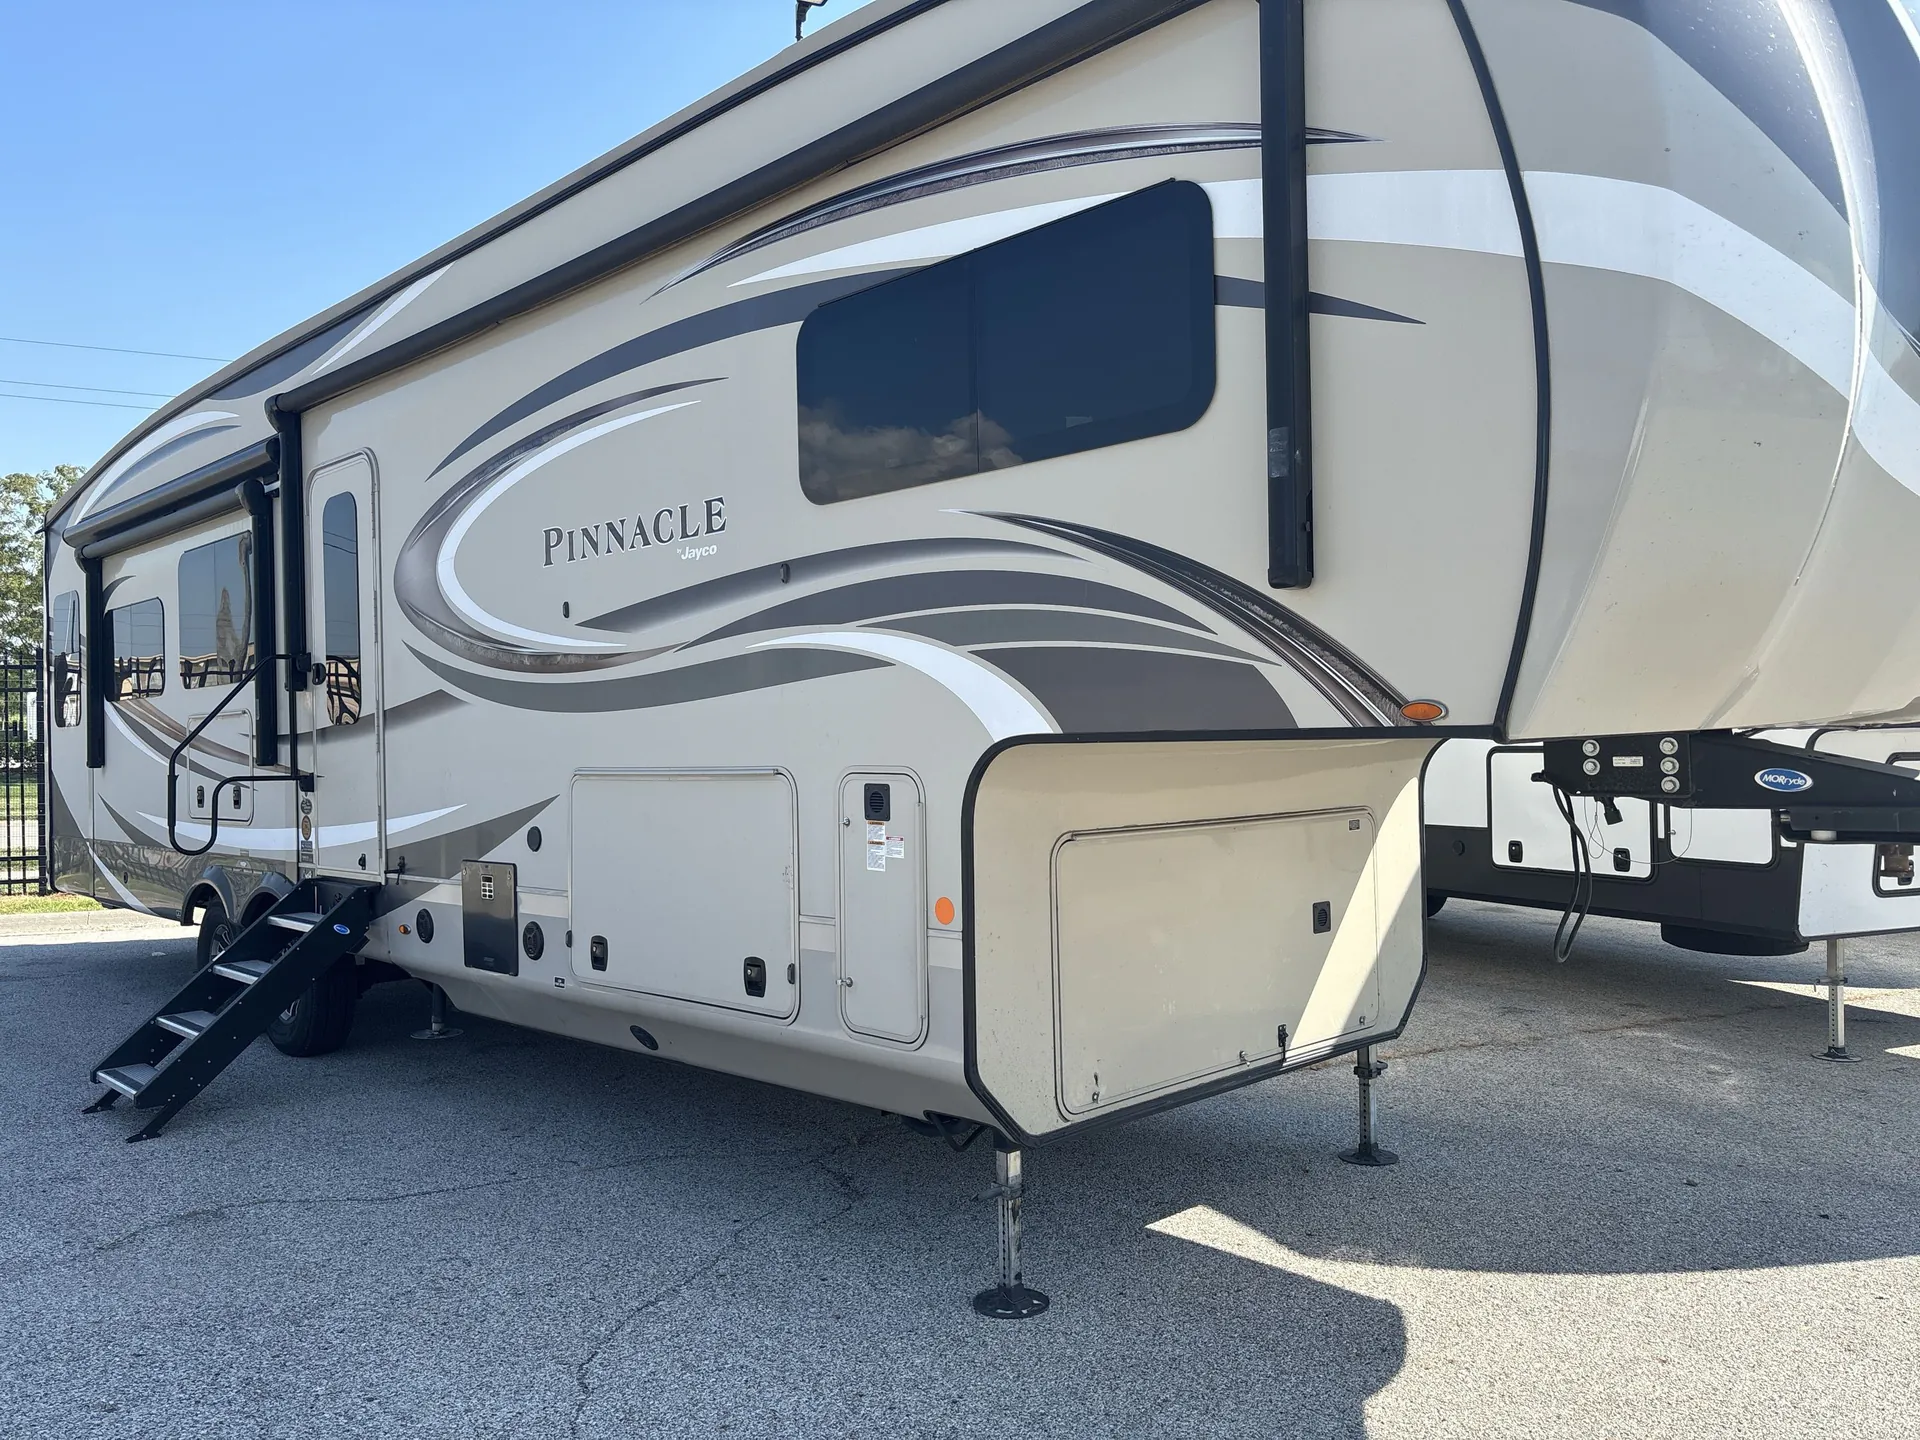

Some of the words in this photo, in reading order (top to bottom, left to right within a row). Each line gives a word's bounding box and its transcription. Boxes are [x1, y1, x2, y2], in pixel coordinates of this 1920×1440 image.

[543, 497, 727, 567] PINNACLE
[681, 545, 717, 560] Jayco
[1762, 774, 1805, 785] MORryde
